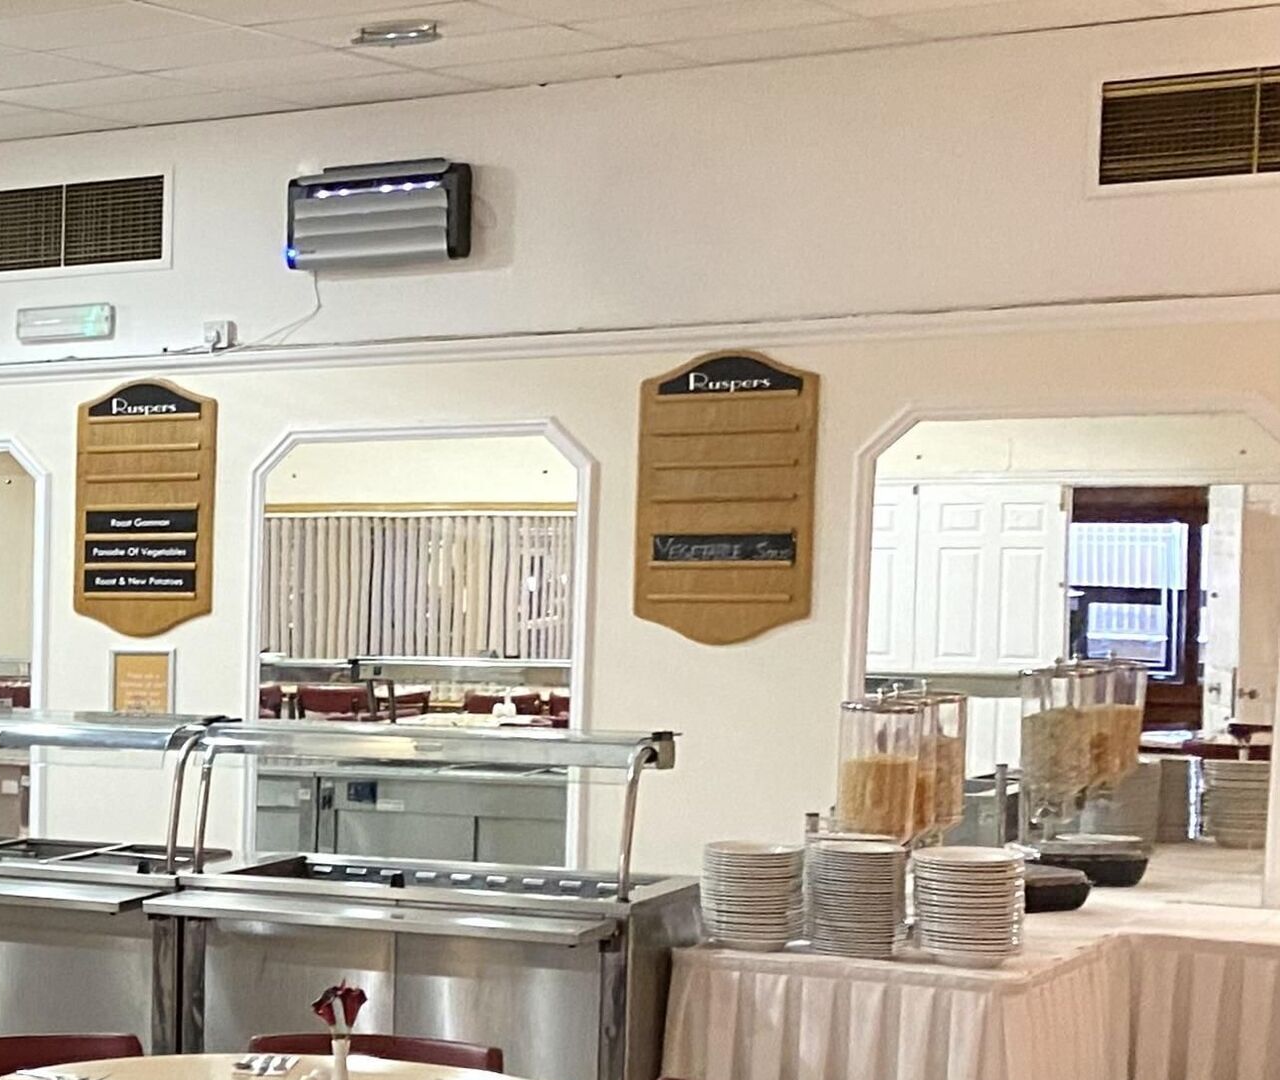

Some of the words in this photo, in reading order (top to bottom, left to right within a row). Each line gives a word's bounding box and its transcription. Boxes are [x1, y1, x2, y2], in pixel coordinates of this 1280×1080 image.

[689, 372, 771, 393] Ruspers
[111, 398, 177, 416] Ruspers
[110, 518, 133, 528] Roast
[127, 547, 140, 557] Of
[141, 547, 187, 559] Vegetables
[95, 576, 117, 586] Roast
[118, 576, 127, 586] &
[127, 577, 147, 586] New
[148, 576, 184, 586] Potatoes
